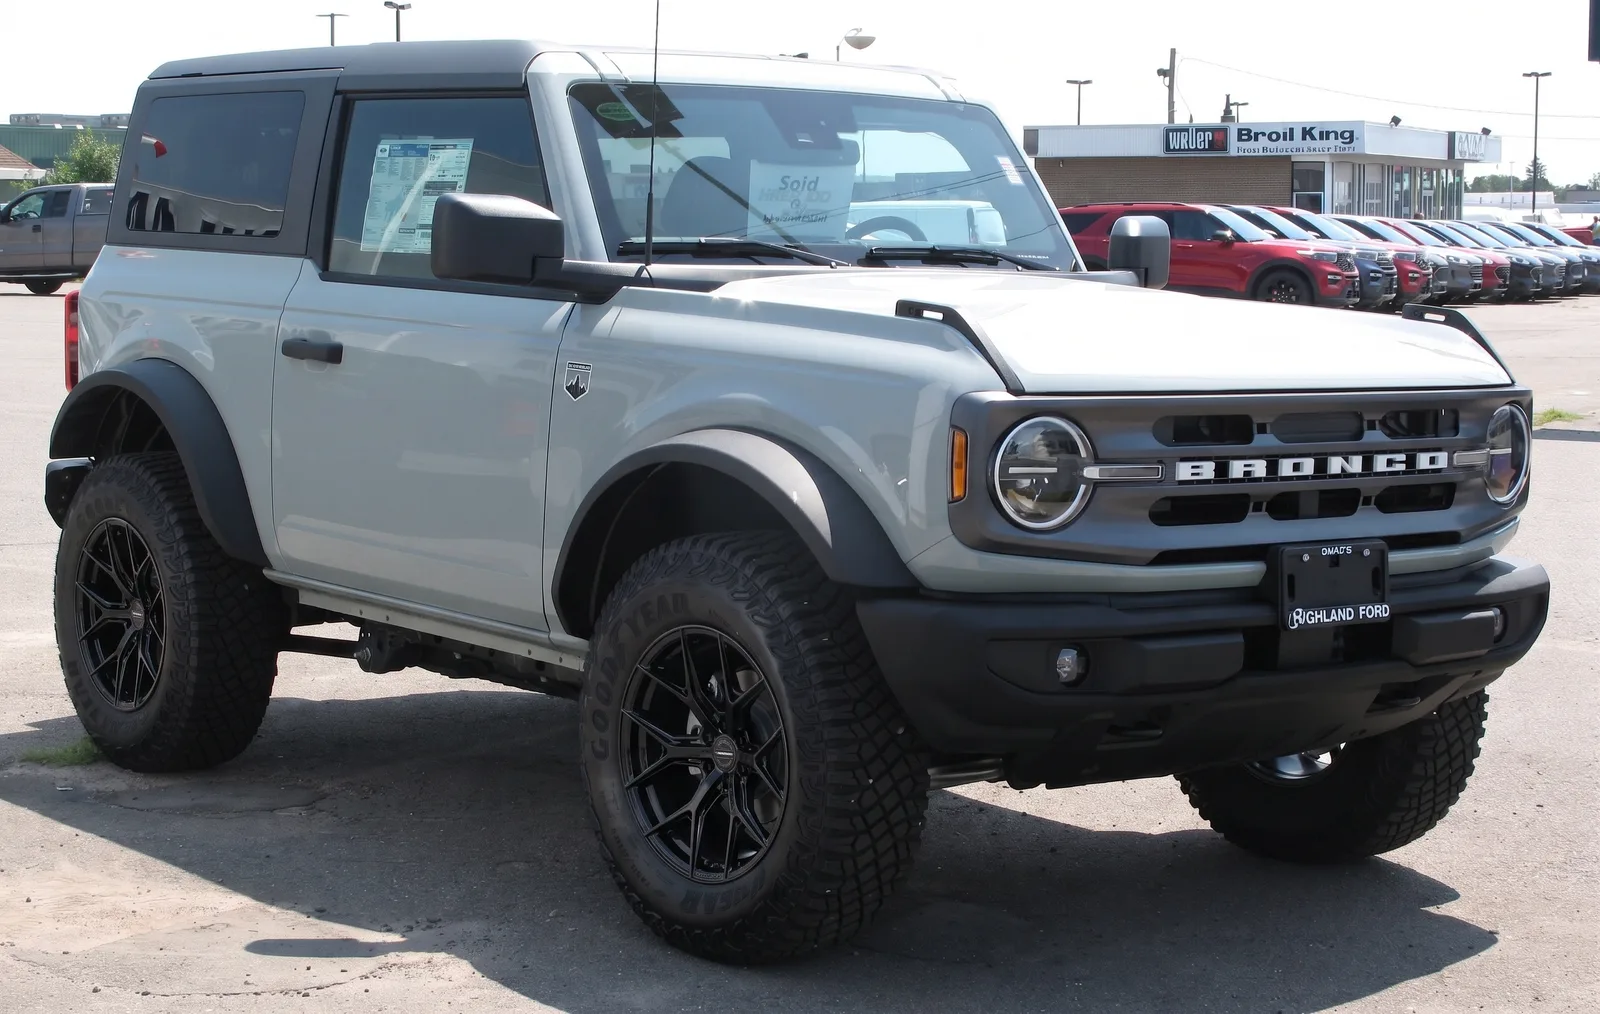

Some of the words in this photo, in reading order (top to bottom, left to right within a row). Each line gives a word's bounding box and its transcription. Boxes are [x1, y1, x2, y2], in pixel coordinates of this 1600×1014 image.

[1237, 127, 1294, 142] Broil
[1302, 127, 1354, 145] King
[1175, 451, 1448, 481] BRONCO
[1359, 604, 1390, 619] FORD
